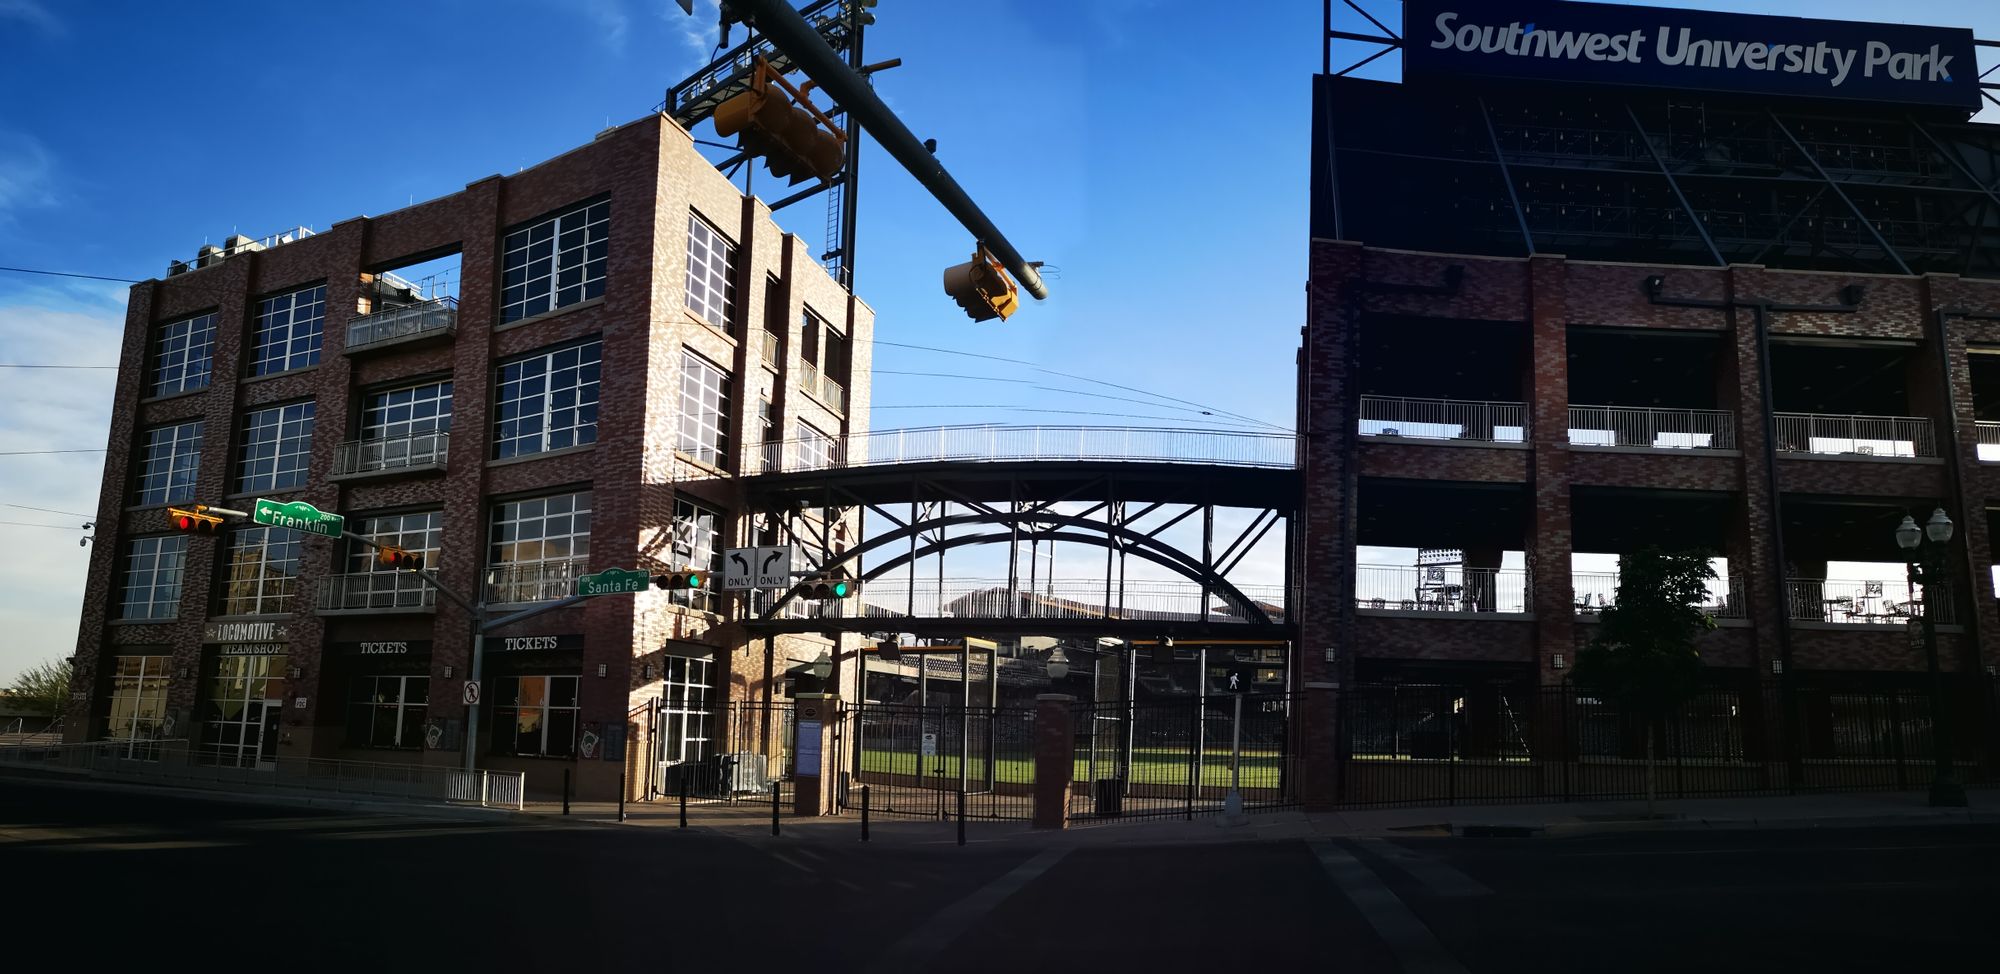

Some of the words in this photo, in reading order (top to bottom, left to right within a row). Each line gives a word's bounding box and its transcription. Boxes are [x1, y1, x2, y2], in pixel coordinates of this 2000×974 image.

[1430, 11, 1647, 65] Southwest
[1655, 25, 1858, 88] University
[1863, 39, 1955, 84] Park
[272, 511, 328, 535] Franklin
[588, 580, 621, 594] Santa
[625, 578, 639, 591] Fe
[728, 576, 752, 587] ONLY
[760, 575, 784, 585] ONLY
[217, 622, 276, 641] LOCOMOTIVE
[225, 644, 253, 655] TEAM
[254, 643, 282, 654] SHOP
[360, 641, 408, 655] TICKETS
[505, 635, 558, 651] TICKETS
